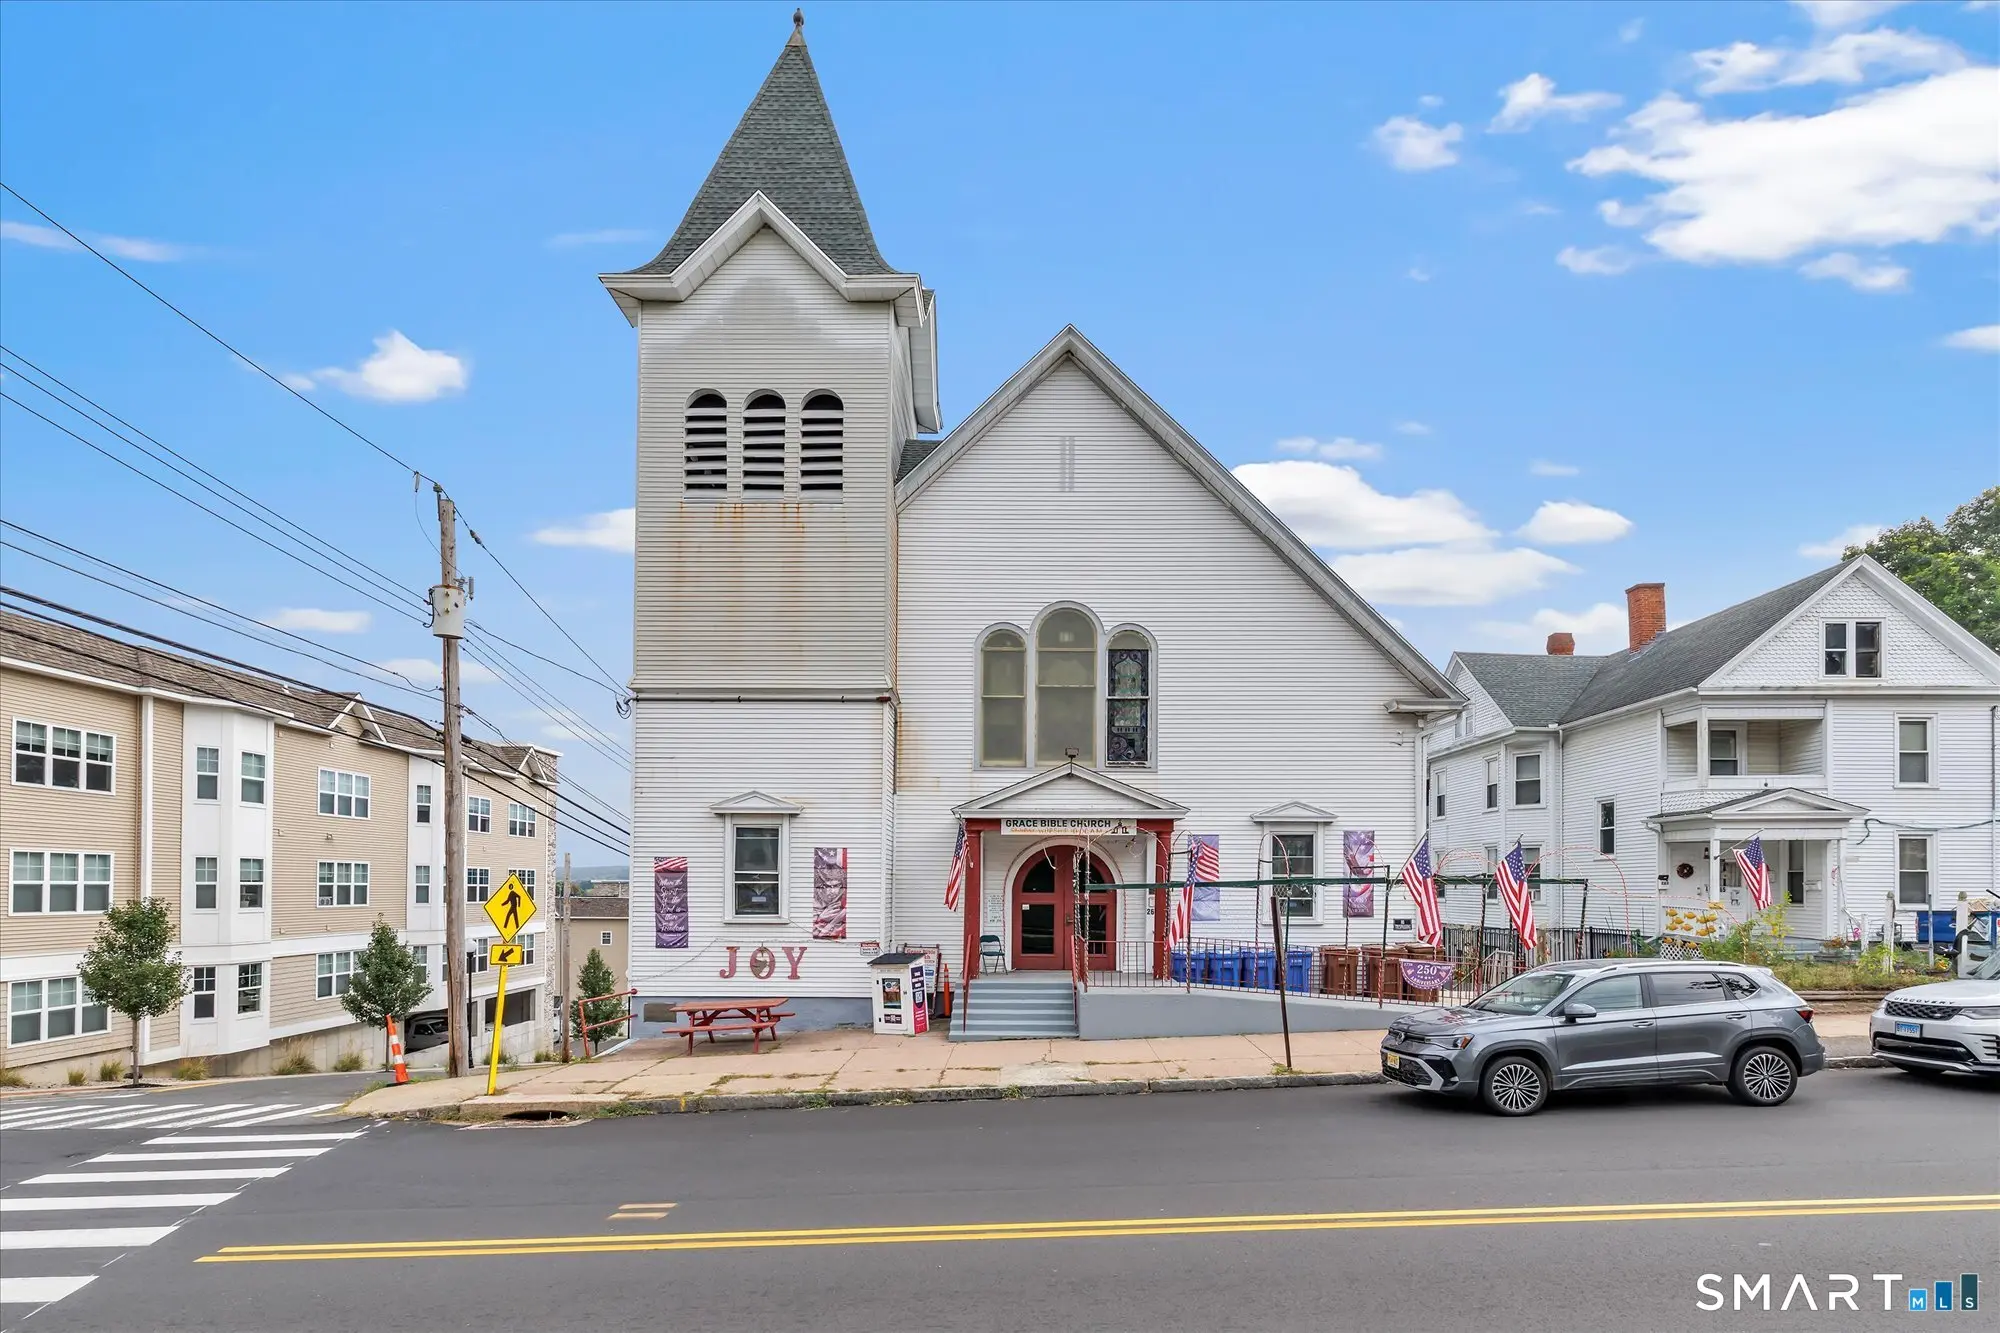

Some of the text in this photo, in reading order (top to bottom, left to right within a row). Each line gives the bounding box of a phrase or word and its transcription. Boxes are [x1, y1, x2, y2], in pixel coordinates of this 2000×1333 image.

[1005, 819, 1111, 828] GRACE BIBLE CHURCH
[718, 945, 808, 980] JOY
[1416, 964, 1438, 976] 250
[1894, 996, 1955, 1005] DISCOVERY
